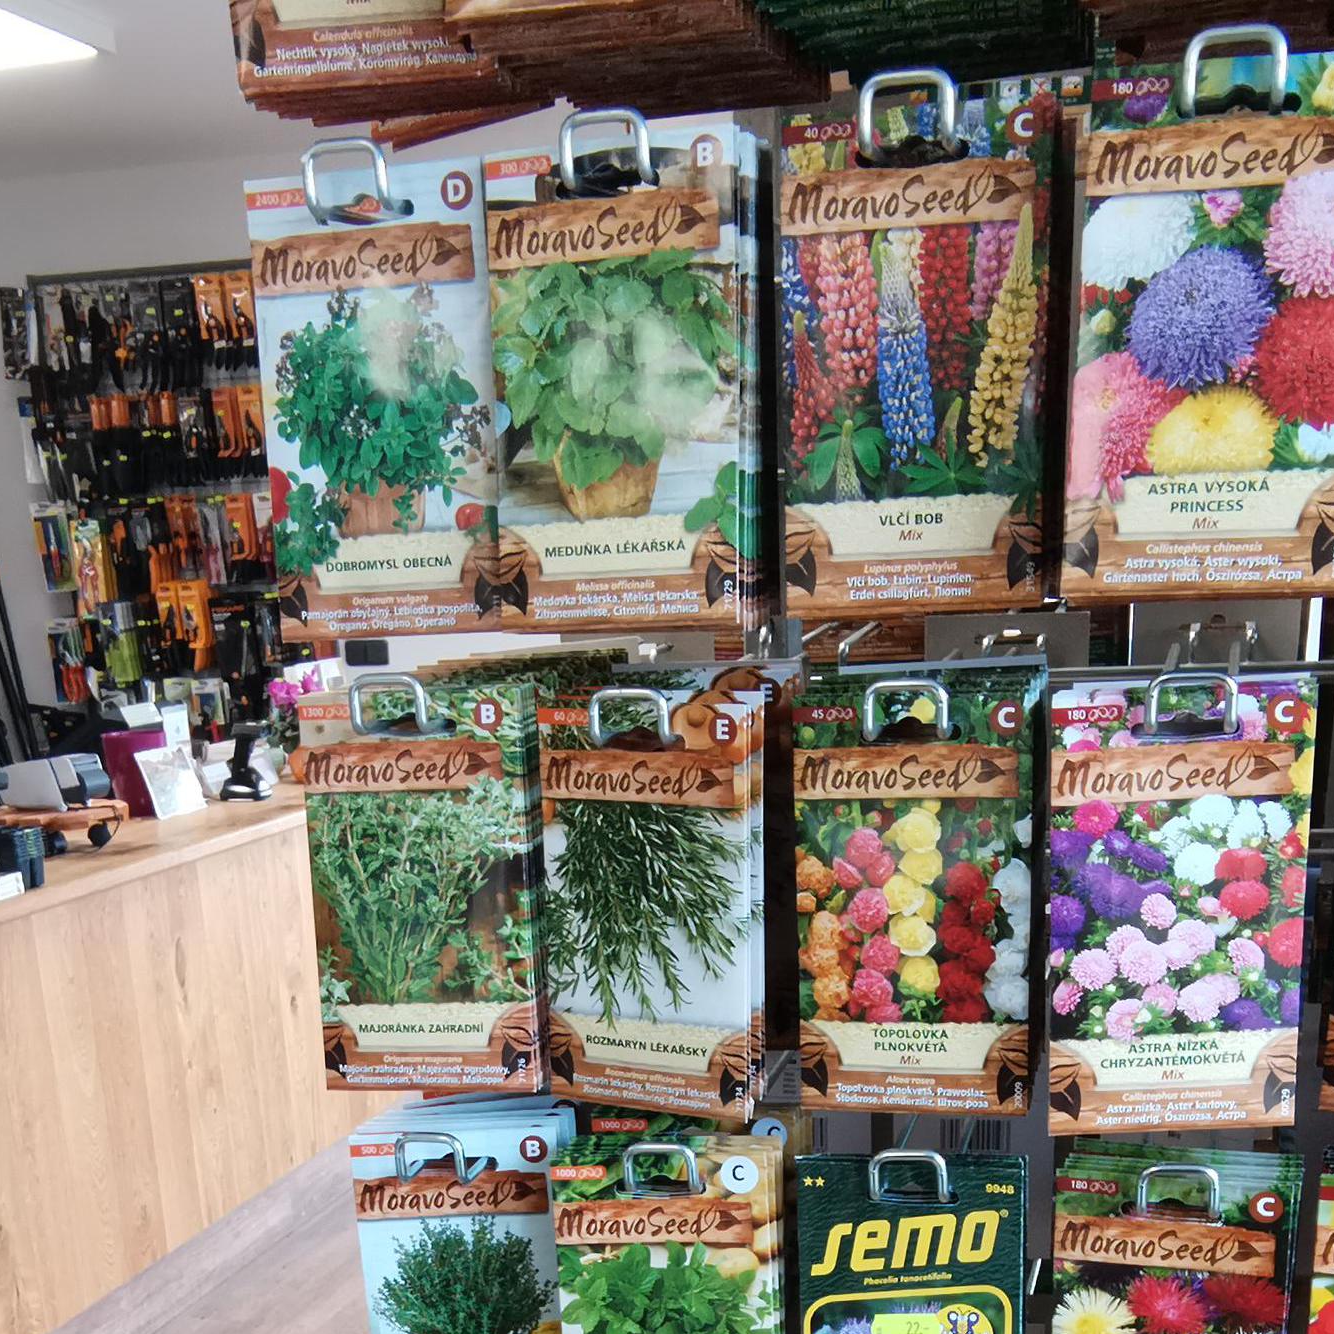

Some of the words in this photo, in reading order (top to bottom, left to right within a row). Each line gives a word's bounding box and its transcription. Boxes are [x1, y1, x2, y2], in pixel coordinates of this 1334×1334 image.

[1097, 131, 1299, 184] MoravoSeed
[788, 177, 977, 224] MoravoSeed
[493, 206, 672, 257] MoravoSeed
[261, 238, 429, 287] MoravoSeed
[1148, 479, 1199, 495] ASTRA
[1204, 475, 1271, 494] VYSOKÁ
[1170, 499, 1245, 513] PRINCESS
[879, 512, 911, 527] VLČÍ
[915, 512, 944, 525] BOB
[1192, 516, 1219, 530] Mix
[899, 529, 924, 541] Mix
[545, 541, 613, 558] MEDUŇKA
[326, 558, 399, 573] DOBROMYSL
[306, 750, 455, 786] MoravoSeed
[548, 756, 694, 796] MoravoSeed
[800, 754, 971, 793] MoravoSeed
[1053, 752, 1241, 797] MoravoSeed
[358, 1020, 425, 1034] MAJORÁNKA
[428, 1020, 485, 1034] ZAHRADNÍ
[872, 1026, 949, 1041] TOPOLOVKA
[874, 1037, 948, 1054] PLNOKVĚTÁ
[1128, 1040, 1172, 1056] ASTRA
[1176, 1036, 1220, 1054] NÍZKÁ
[899, 1054, 922, 1067] Mix
[1161, 1068, 1186, 1082] Mix
[360, 1181, 505, 1214] MoravoSeed
[986, 1182, 1015, 1196] 9948
[557, 1202, 705, 1239] MoravoSeed
[1060, 1221, 1225, 1266] MoravoSeed
